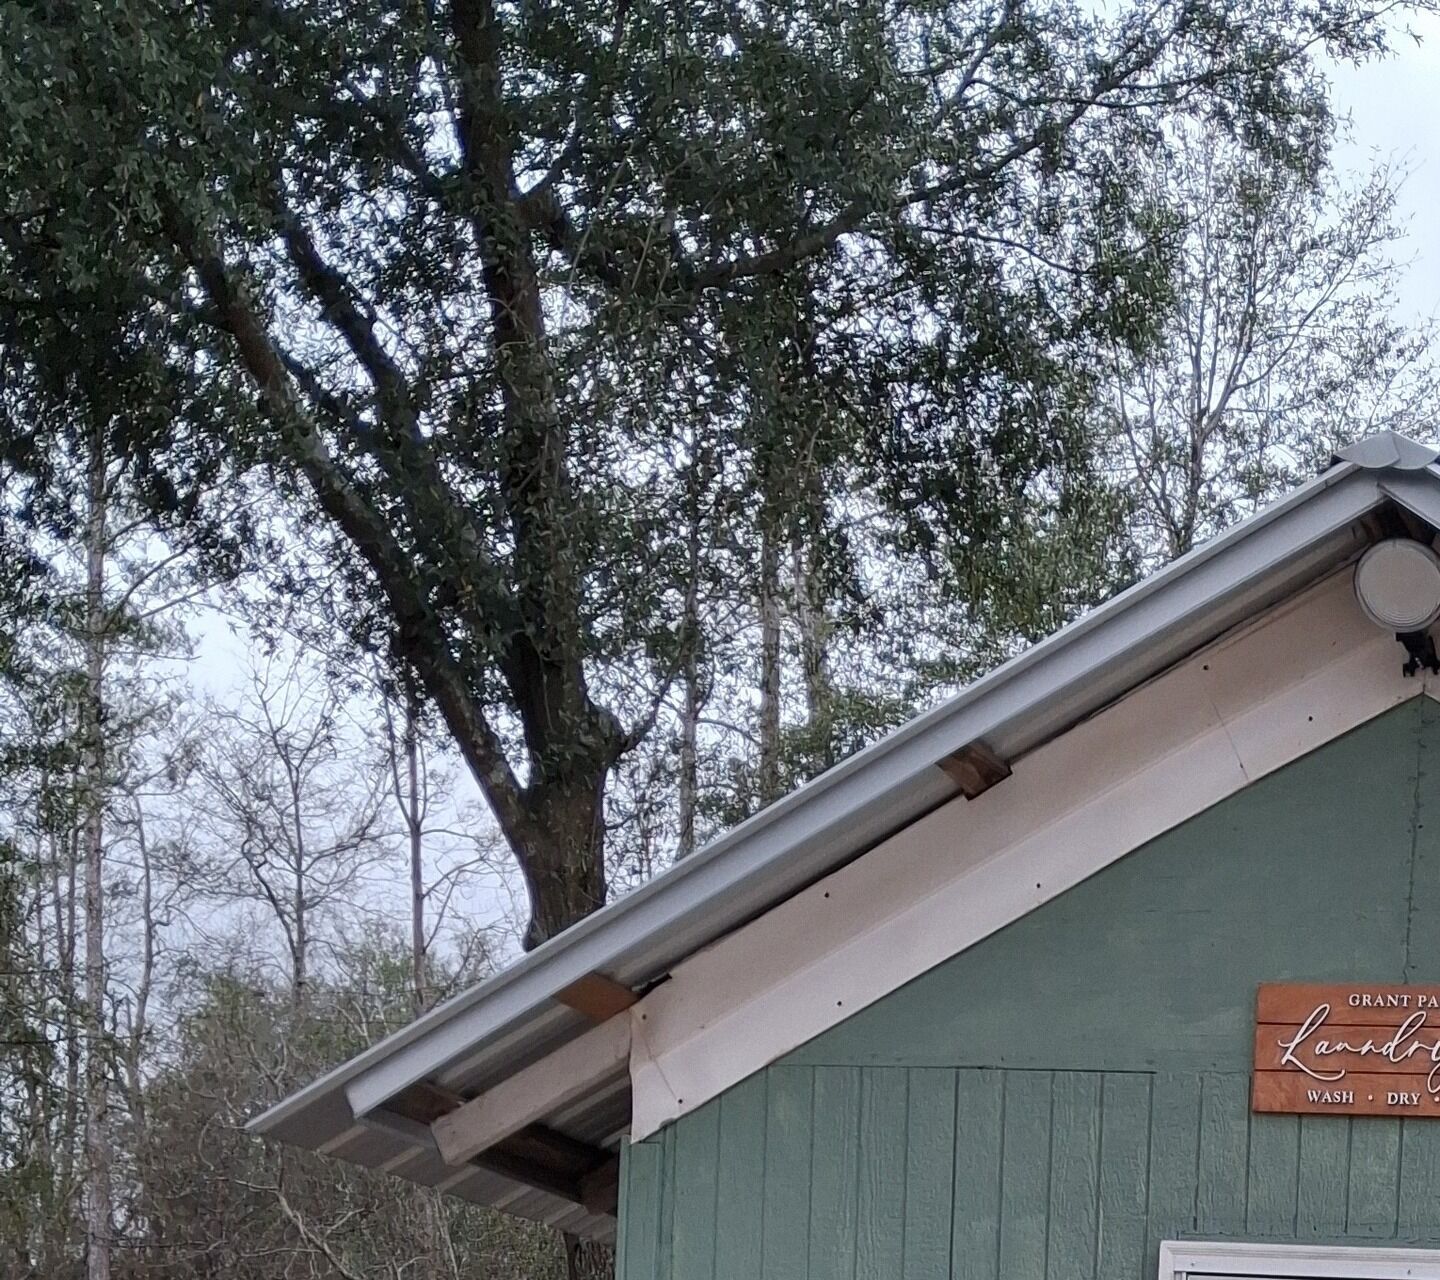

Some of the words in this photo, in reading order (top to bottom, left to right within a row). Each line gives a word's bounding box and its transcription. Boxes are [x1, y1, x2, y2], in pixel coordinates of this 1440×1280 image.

[1349, 993, 1411, 1007] GRANT
[1307, 1090, 1354, 1104] WASH
[1387, 1092, 1421, 1105] DRY
